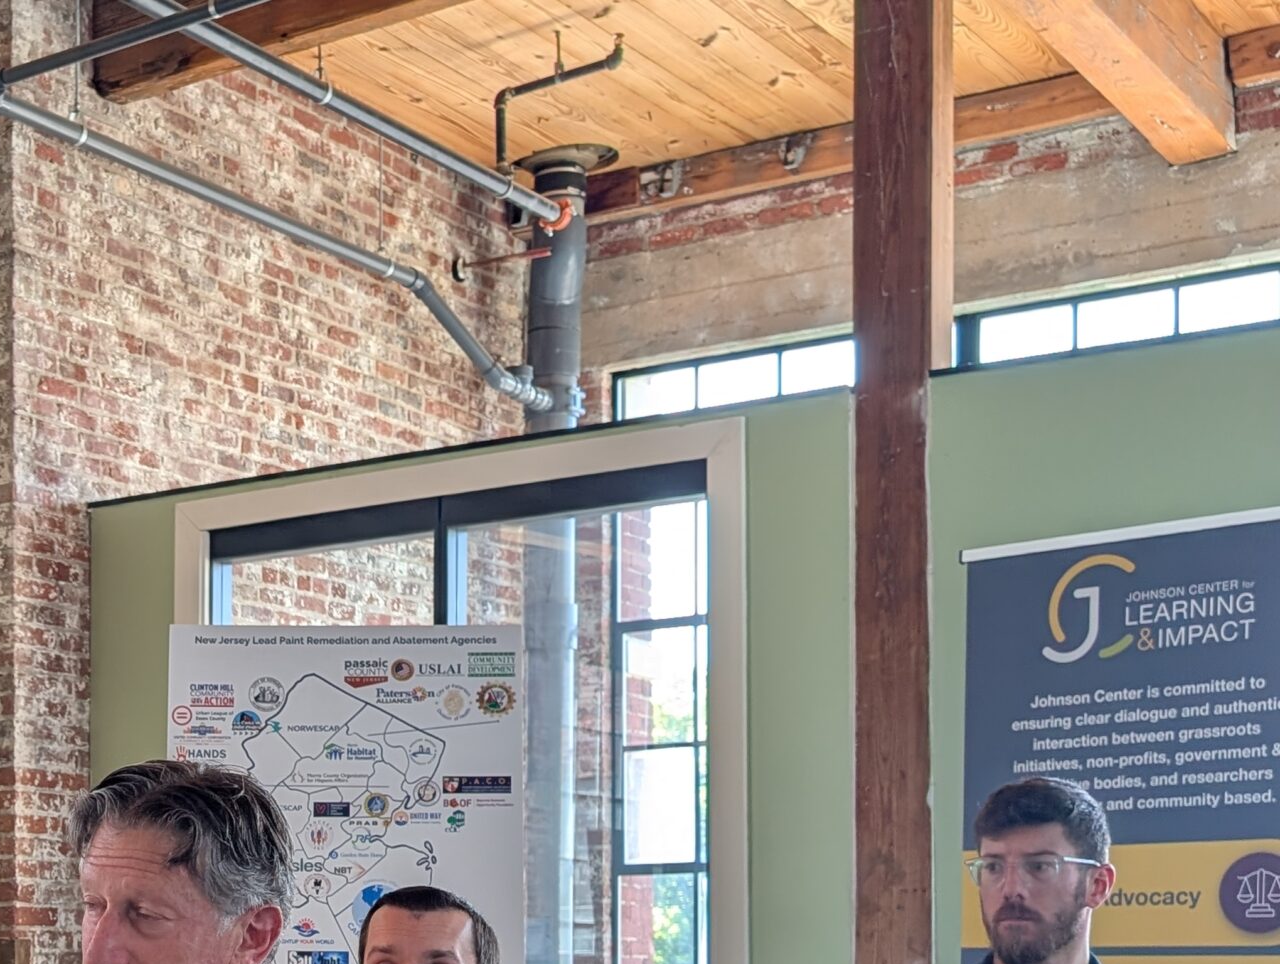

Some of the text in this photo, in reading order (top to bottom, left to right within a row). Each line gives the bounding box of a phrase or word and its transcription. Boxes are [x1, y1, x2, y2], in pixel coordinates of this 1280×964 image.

[1126, 579, 1255, 603] JOHNSON CENTER for
[1124, 592, 1255, 626] LEARNING
[194, 635, 497, 647] New Jersey Lead Paint Remediation and Abatement Agencies
[1137, 619, 1256, 651] & IMPACT
[344, 657, 389, 670] passaic
[468, 656, 515, 664] COMMUNITY
[347, 668, 388, 676] COUNTY
[418, 663, 462, 675] USLAI
[468, 665, 515, 673] DEVELOPMENT
[189, 683, 234, 691] CLINTON HILL
[1030, 676, 1266, 708] Johnson Center is committed to
[204, 697, 234, 705] ACTION
[1011, 715, 1072, 731] ensuring
[1075, 712, 1111, 726] clear
[1114, 708, 1177, 723] dialogue
[1181, 702, 1209, 718] and
[286, 724, 341, 733] NORWESCAP
[1032, 722, 1261, 751] interaction between grassroots
[187, 749, 227, 759] HANDS
[346, 747, 376, 756] Habitat
[1013, 757, 1083, 773] initiatives,
[1086, 751, 1171, 769] non-profits,
[1175, 744, 1267, 765] government
[1093, 775, 1146, 790] bodies,
[1150, 771, 1178, 787] and
[1181, 767, 1274, 785] researchers
[1106, 796, 1133, 811] and
[1136, 792, 1221, 810] community
[1224, 788, 1276, 806] based.
[291, 857, 324, 872] sles
[333, 866, 353, 874] NBT
